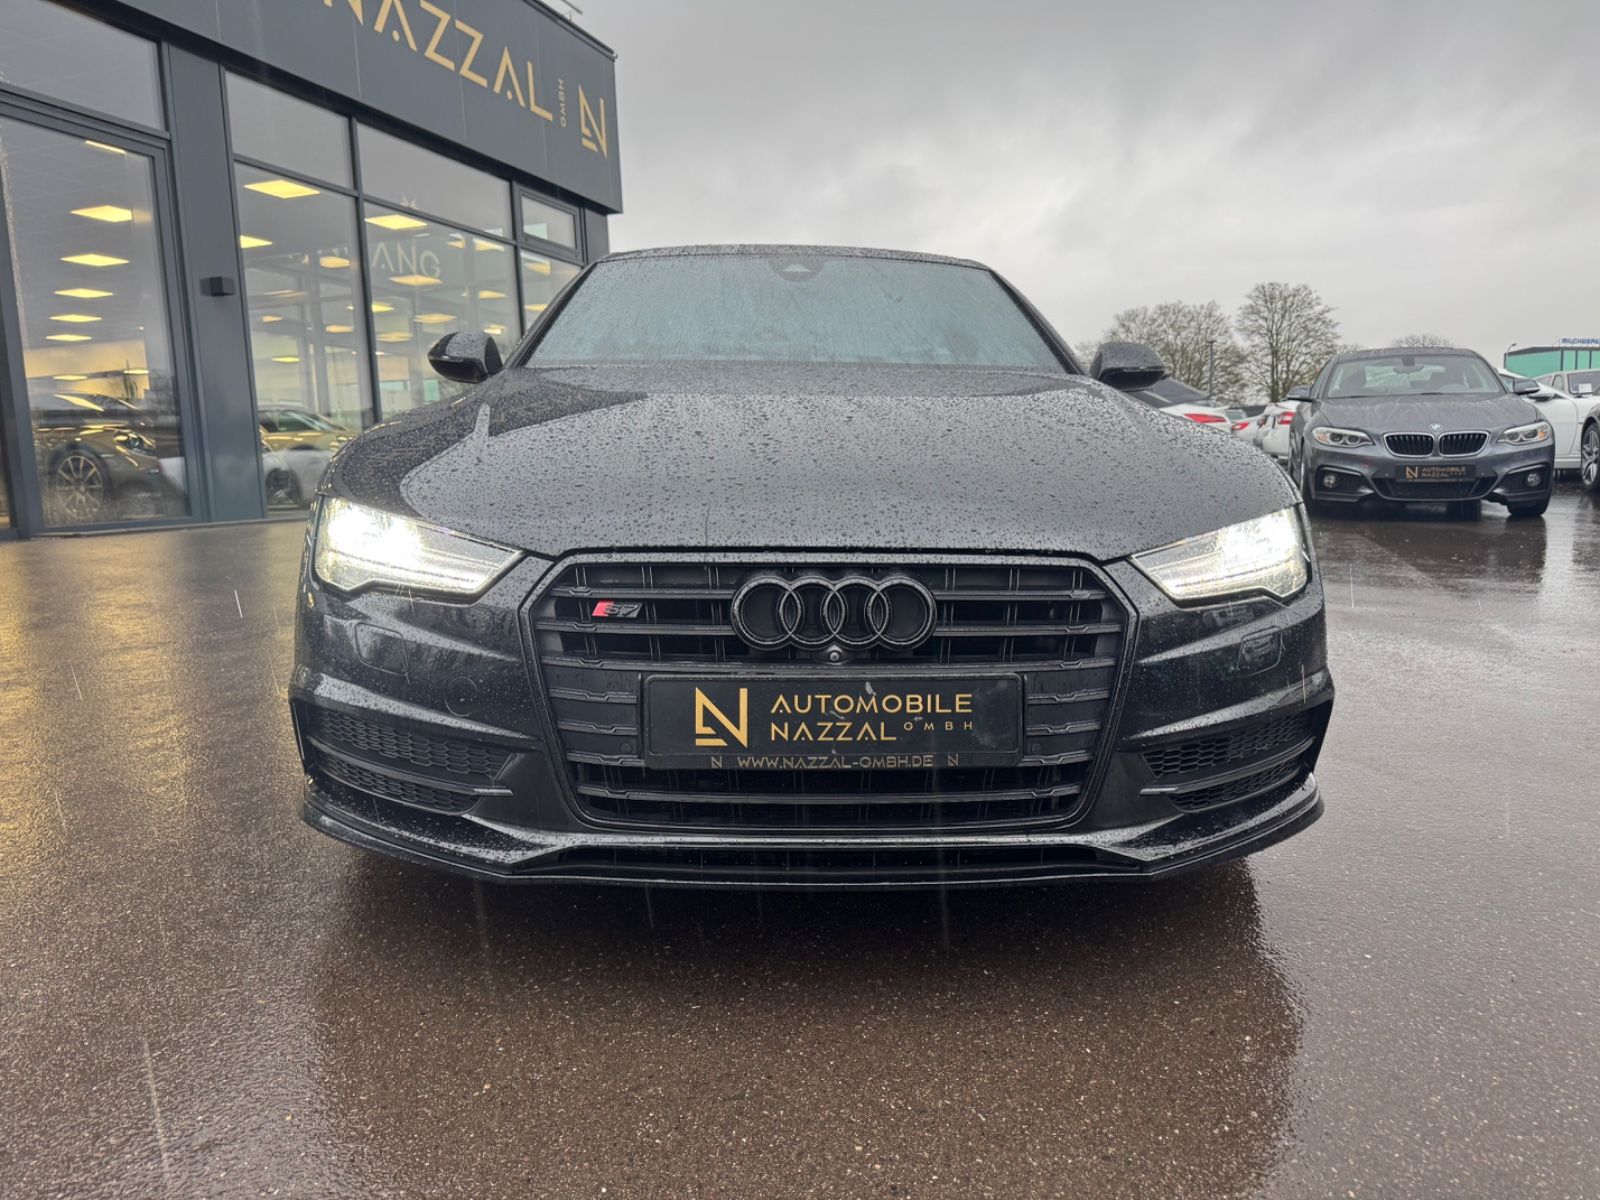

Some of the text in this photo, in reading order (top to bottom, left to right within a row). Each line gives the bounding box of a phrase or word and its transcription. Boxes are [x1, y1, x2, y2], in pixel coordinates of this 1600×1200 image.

[603, 603, 640, 616] S7
[771, 693, 974, 714] AUTOMOBILE
[771, 721, 897, 741] NAZZAL
[737, 755, 934, 770] WWW.NAZZAL-GMBH.DE
